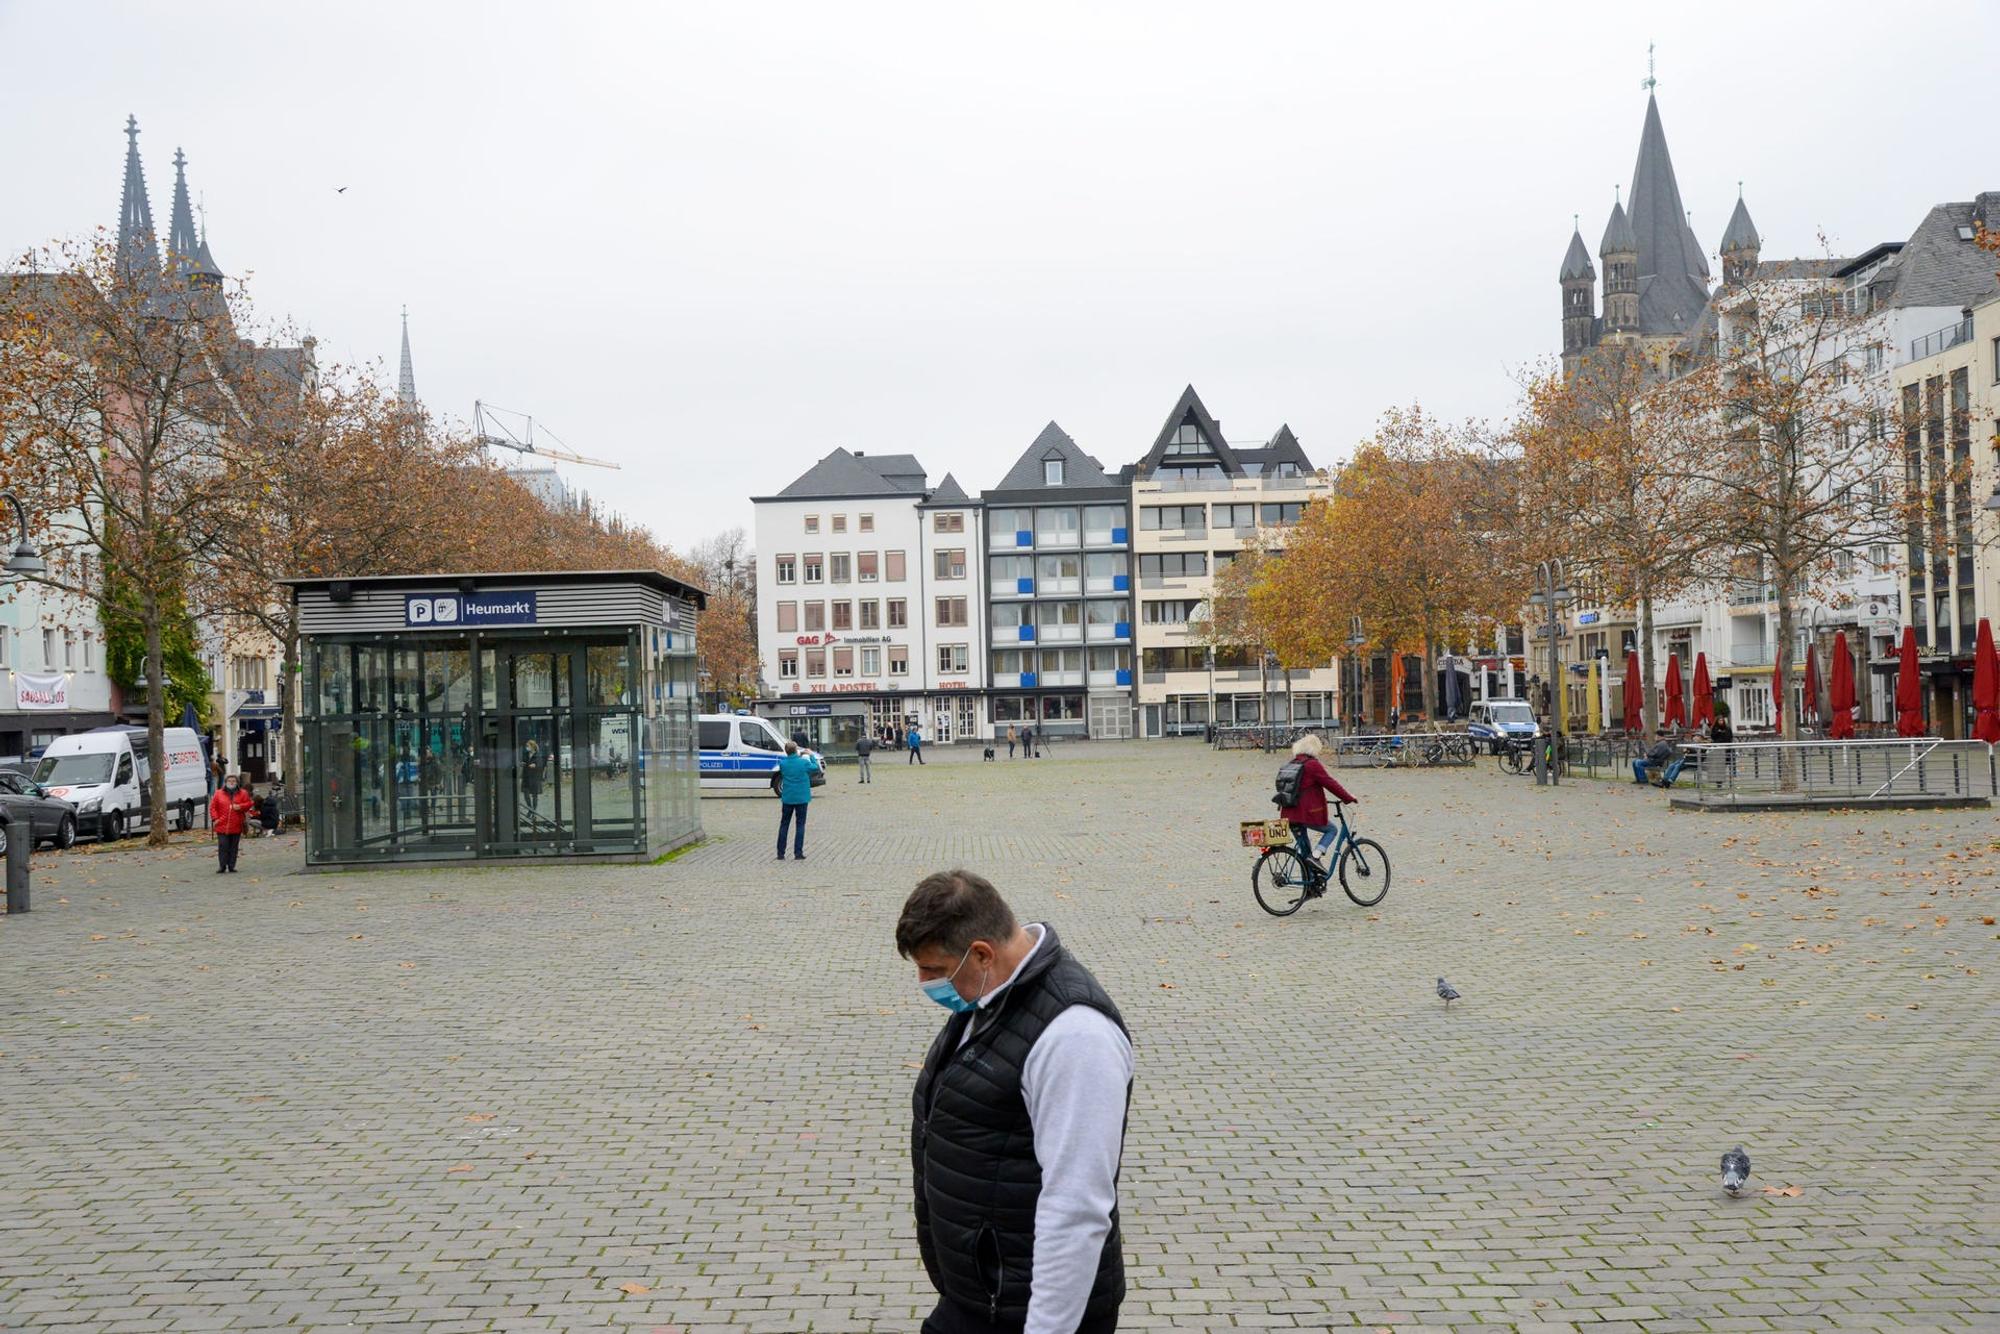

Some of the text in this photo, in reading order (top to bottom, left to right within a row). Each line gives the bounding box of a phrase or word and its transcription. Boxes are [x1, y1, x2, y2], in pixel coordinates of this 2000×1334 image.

[466, 601, 530, 615] Heumarkt
[796, 635, 892, 645] GAG Immobilien AG
[810, 684, 828, 693] XII
[831, 682, 878, 693] APOSTEL
[939, 681, 968, 689] HOTEL
[1268, 828, 1288, 838] UNO
